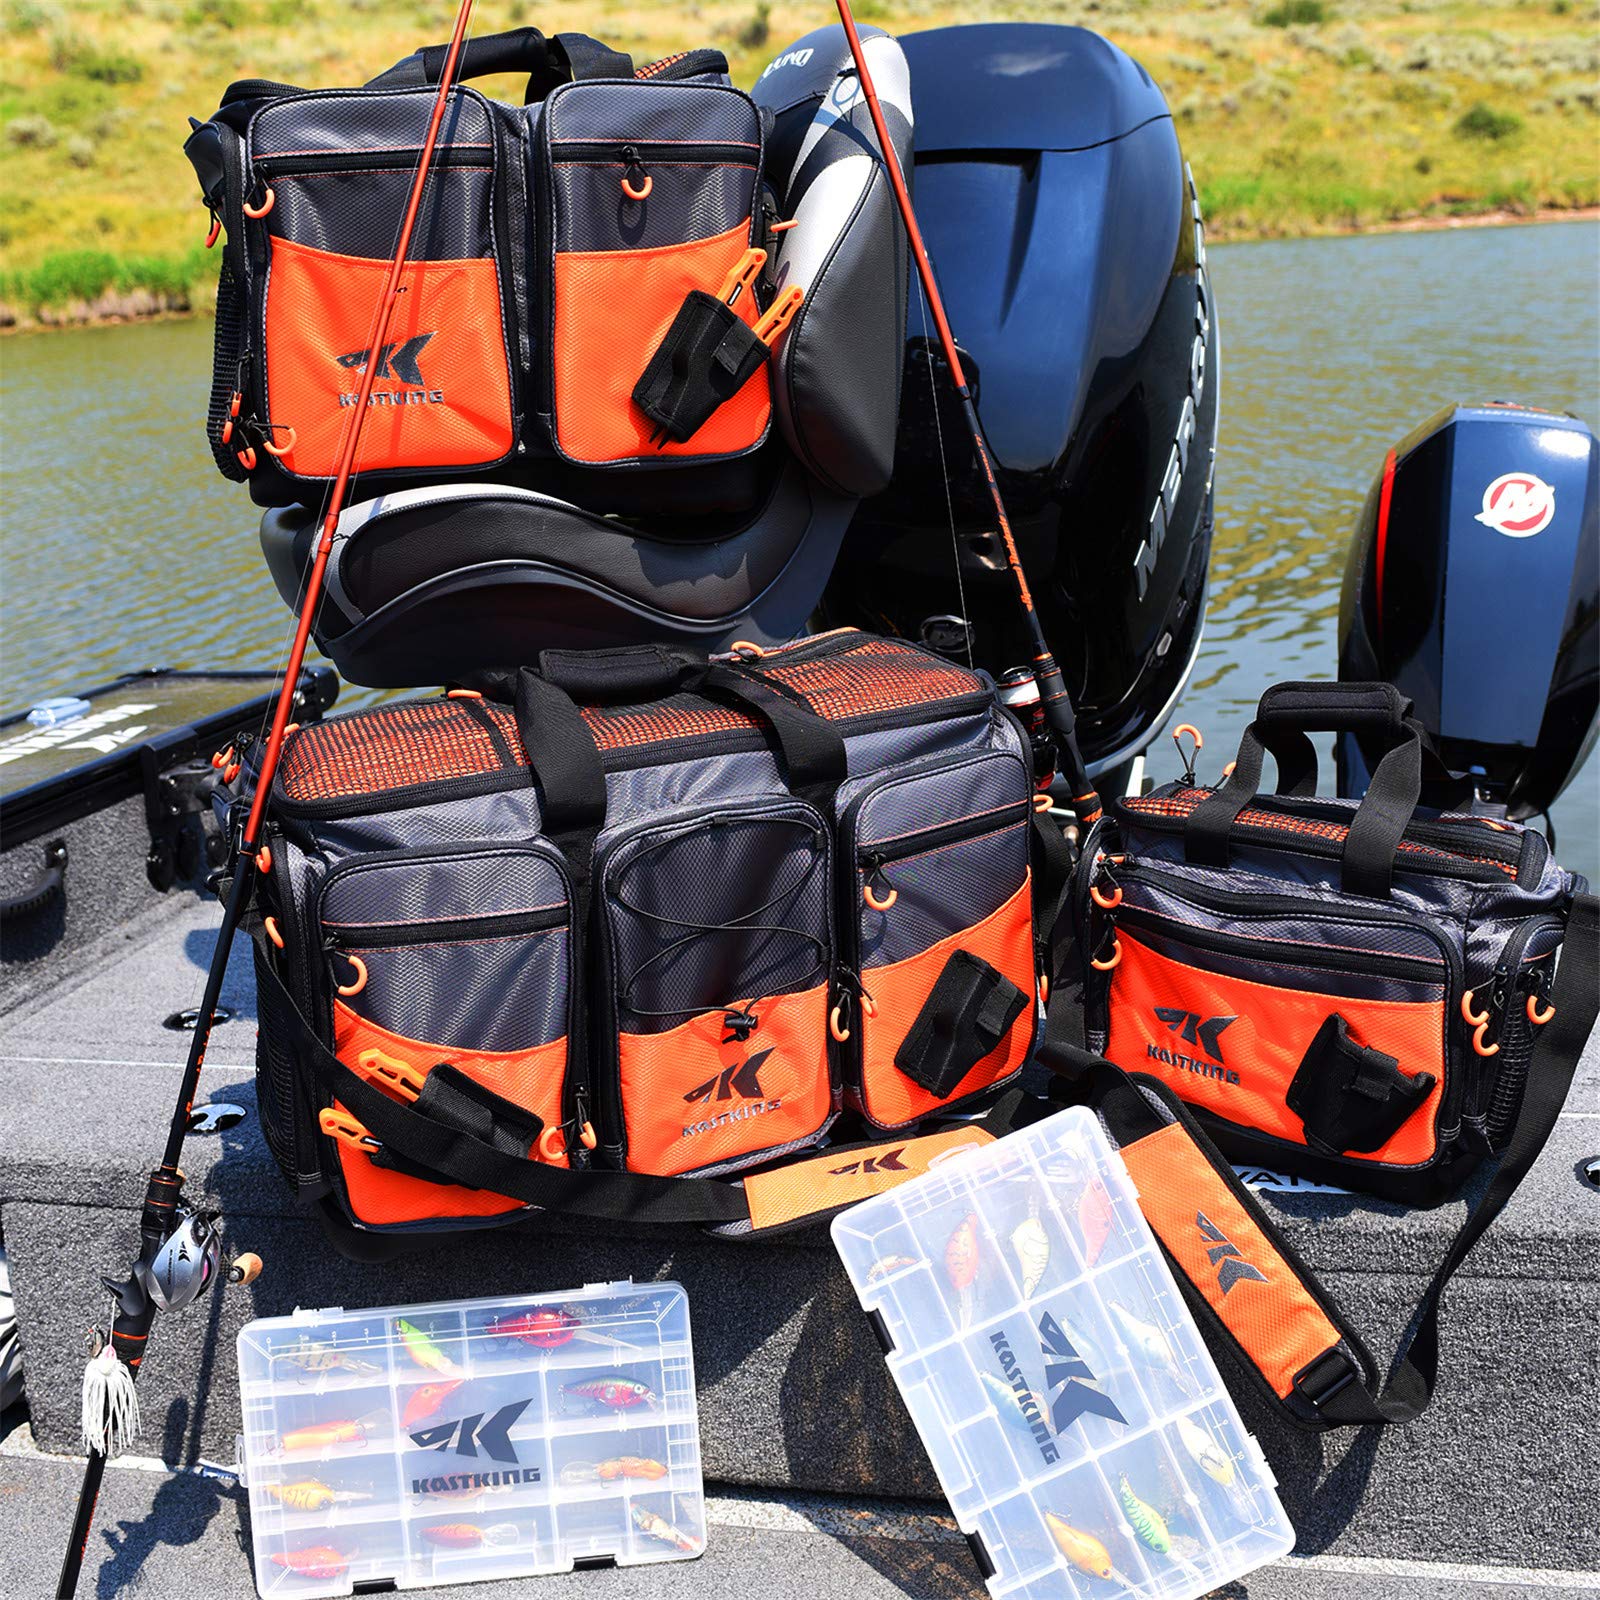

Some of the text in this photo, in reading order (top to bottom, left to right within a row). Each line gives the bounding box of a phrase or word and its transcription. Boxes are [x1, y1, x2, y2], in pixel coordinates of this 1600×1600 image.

[1134, 161, 1209, 602] MERCU
[1147, 1044, 1240, 1086] KASTKING
[682, 1099, 781, 1138] KASTKING
[989, 1330, 1061, 1466] KASTKING
[412, 1467, 541, 1494] KASTKING
